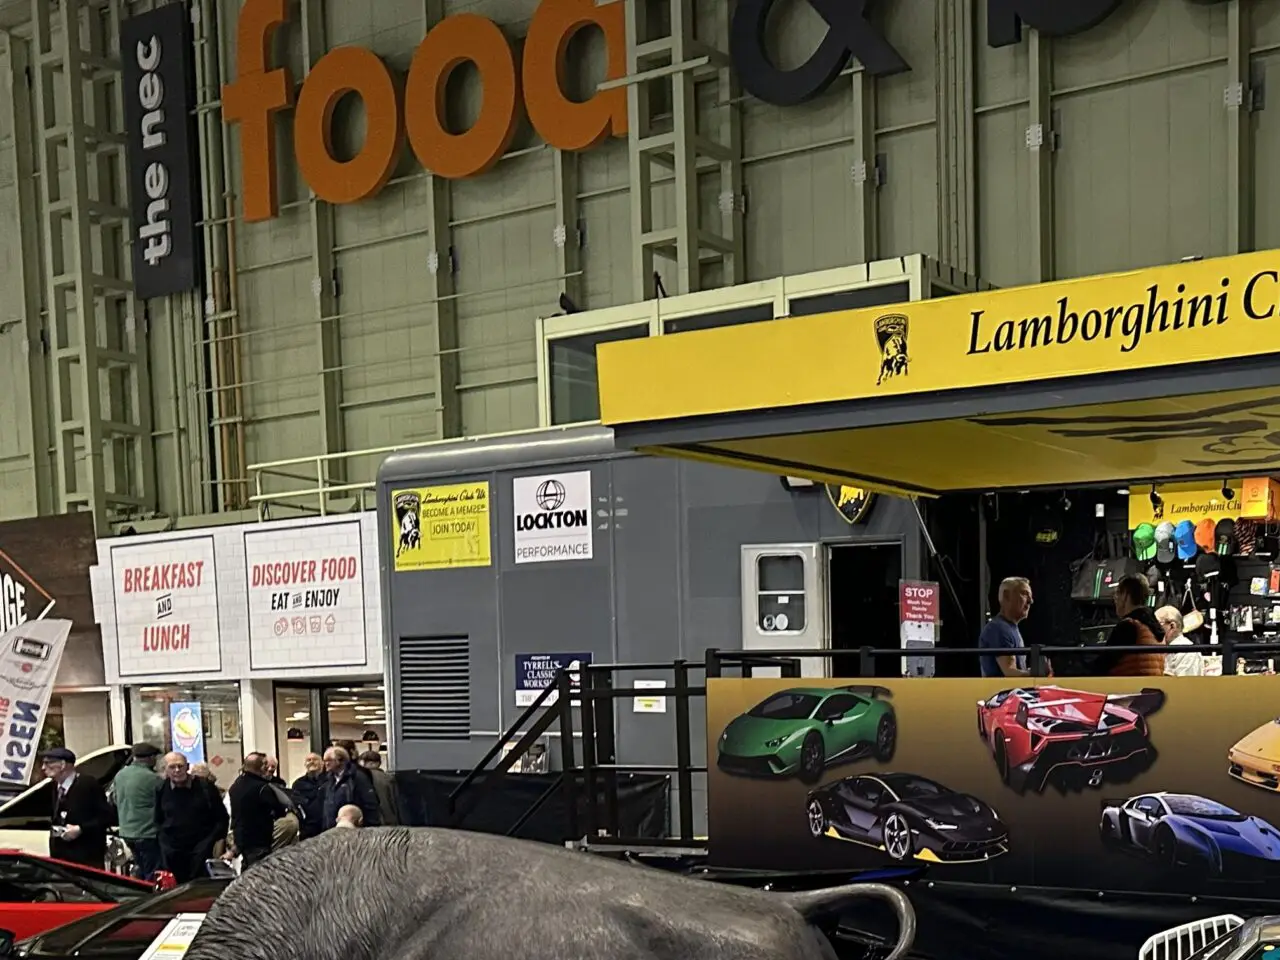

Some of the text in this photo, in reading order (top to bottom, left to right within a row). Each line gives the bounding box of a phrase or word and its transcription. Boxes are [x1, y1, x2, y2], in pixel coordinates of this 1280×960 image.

[136, 34, 173, 266] the nec
[966, 276, 1229, 355] Lamborghini
[422, 493, 459, 505] Lamborghini
[459, 489, 474, 501] Club
[422, 507, 449, 518] BECOME
[450, 507, 455, 516] A
[1170, 500, 1242, 515] Lamborghini Clu
[432, 521, 476, 535] JOIN TODAY
[516, 510, 587, 532] LOCKTON
[516, 543, 589, 559] PERFORMANCE
[123, 560, 204, 593] BREAKFAST
[252, 556, 357, 587] DISCOVER FOOD
[271, 592, 290, 610] EAT
[304, 588, 340, 608] ENJOY
[904, 587, 934, 598] STOP
[157, 600, 172, 616] AND
[143, 623, 190, 652] LUNCH
[527, 670, 556, 679] CLASSIC
